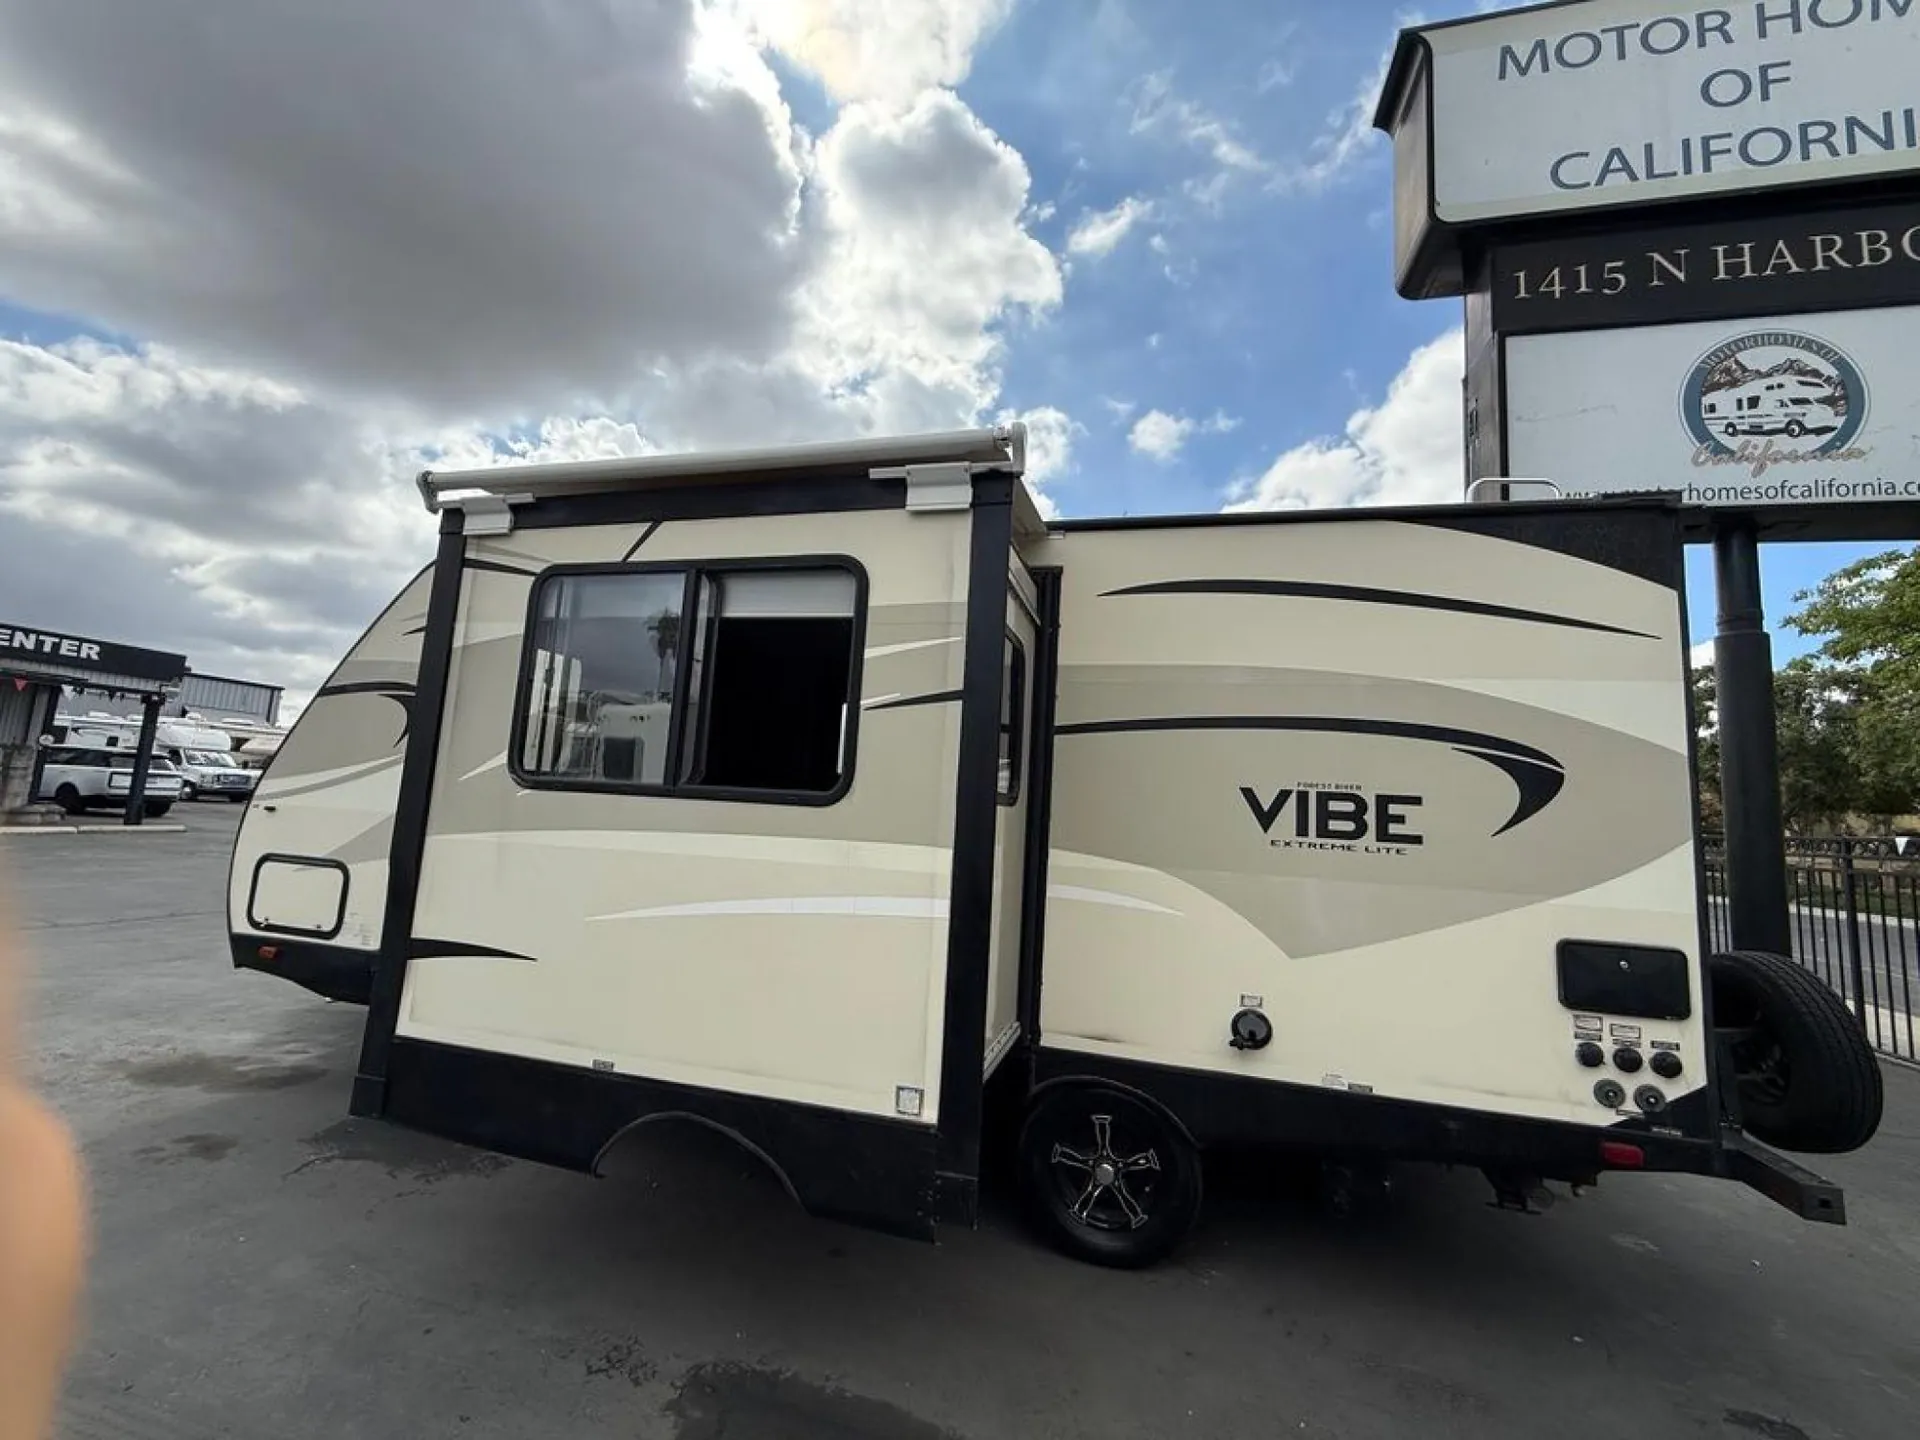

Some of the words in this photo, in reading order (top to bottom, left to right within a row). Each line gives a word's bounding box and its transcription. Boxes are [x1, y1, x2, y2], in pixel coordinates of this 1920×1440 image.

[1498, 10, 1736, 81] MOTOR
[1700, 61, 1792, 107] OF
[1550, 107, 1917, 191] CALIFORNI
[1513, 260, 1627, 300] 1415
[1645, 249, 1690, 287] N
[1238, 786, 1424, 845] VIBE
[1269, 839, 1358, 852] EXTREME
[1364, 845, 1408, 856] LITE
